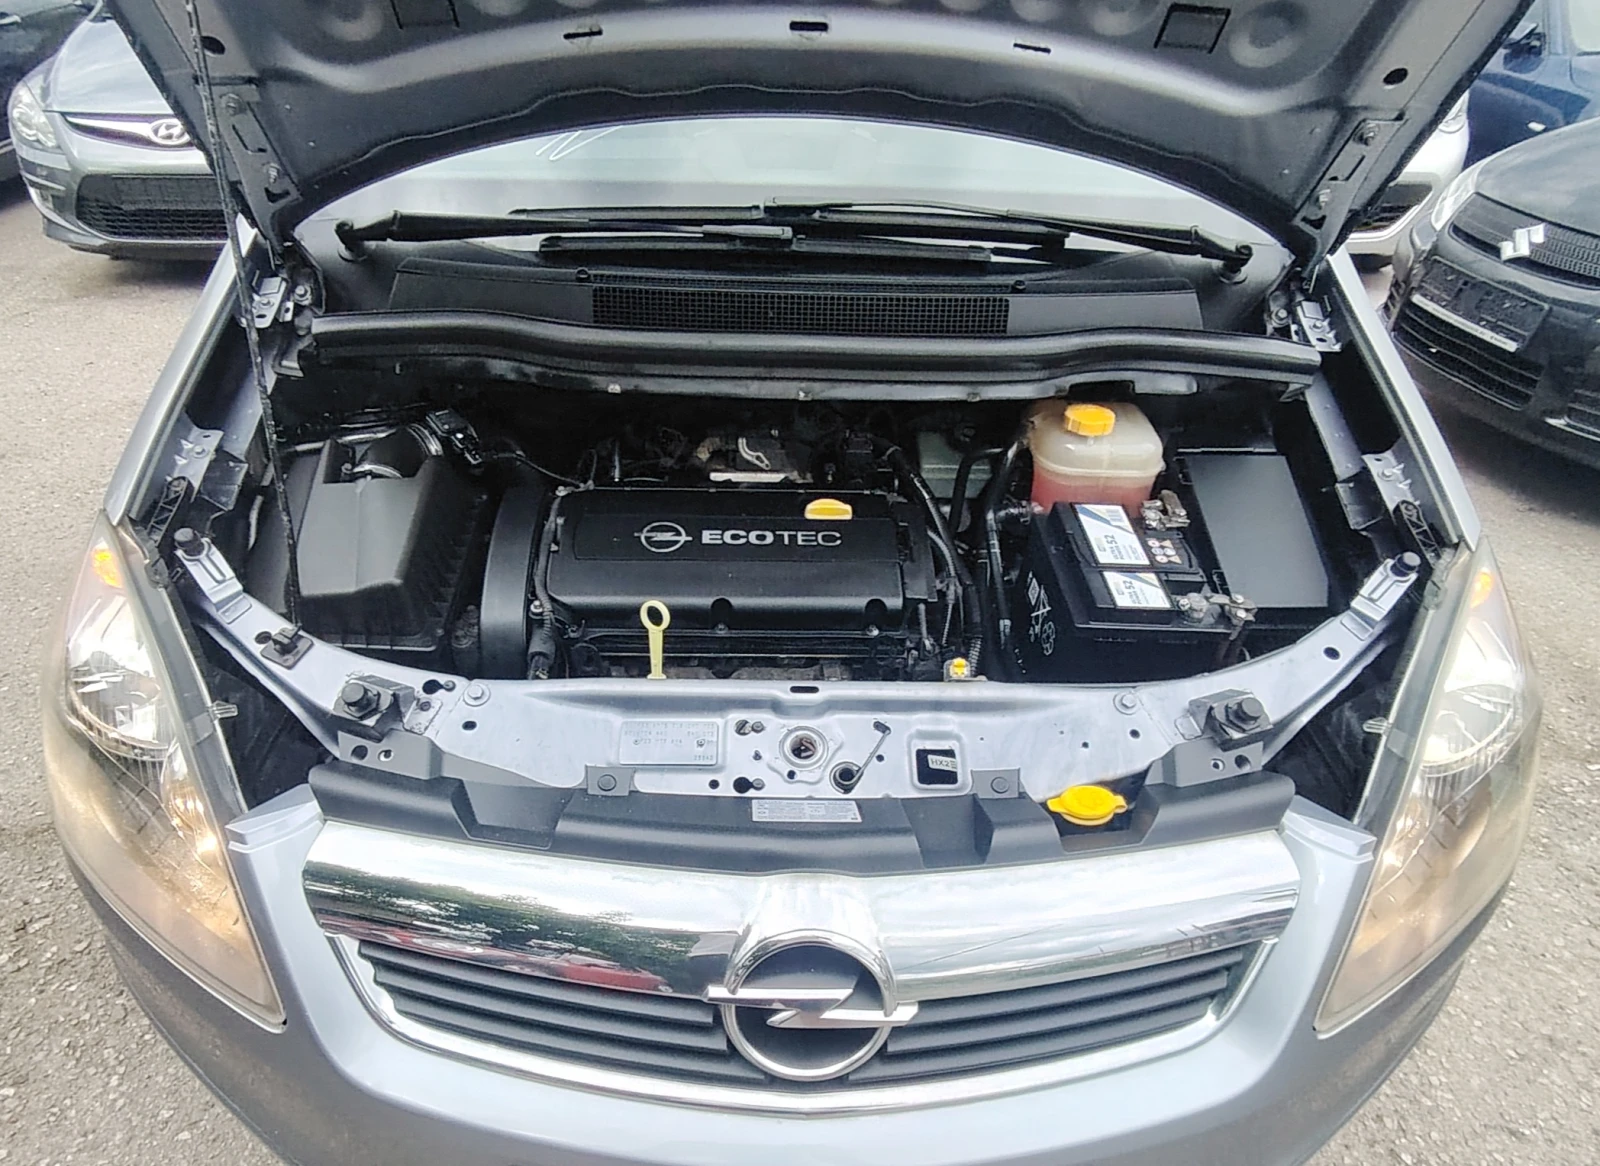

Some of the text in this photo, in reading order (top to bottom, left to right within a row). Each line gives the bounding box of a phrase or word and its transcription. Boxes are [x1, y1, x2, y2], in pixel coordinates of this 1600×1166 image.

[701, 529, 842, 546] ECOTEC
[1104, 534, 1118, 545] 52
[1123, 580, 1135, 590] 52
